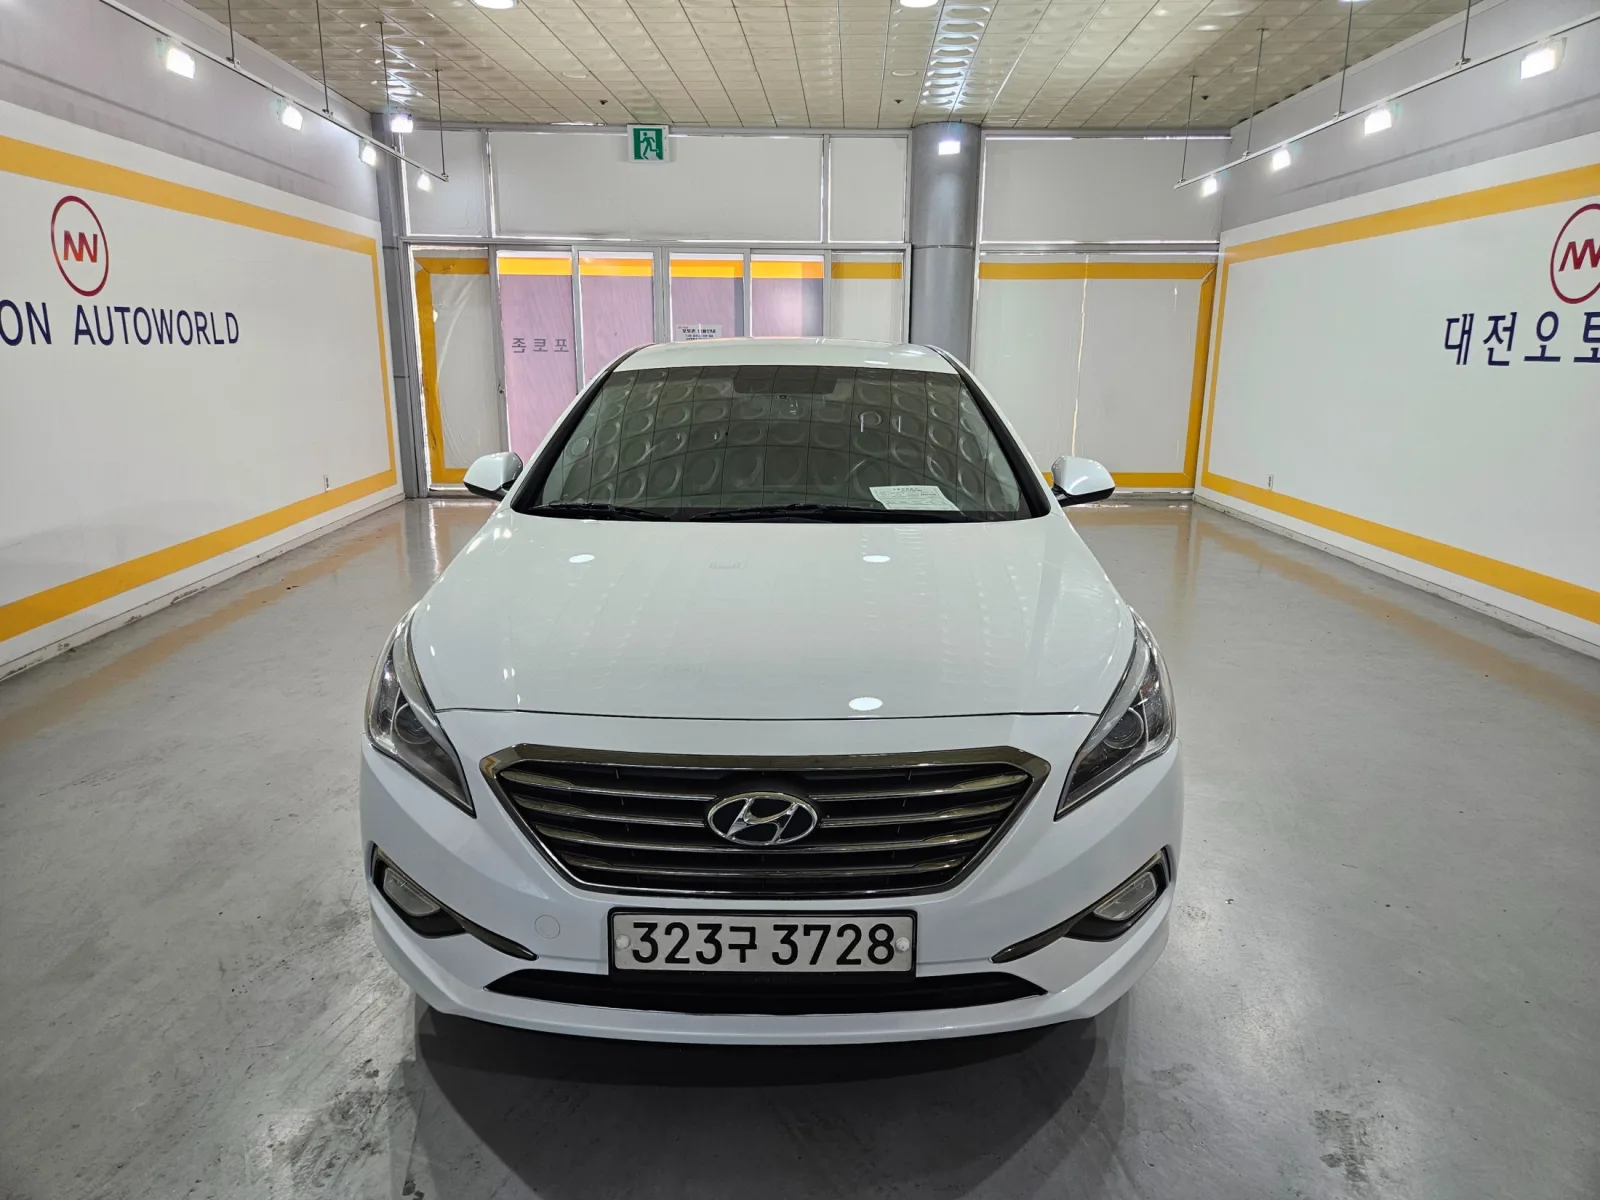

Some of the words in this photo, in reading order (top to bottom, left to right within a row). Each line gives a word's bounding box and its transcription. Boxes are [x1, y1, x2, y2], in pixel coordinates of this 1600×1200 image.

[0, 299, 52, 346] ON
[74, 304, 239, 346] AUTOWORLD
[632, 922, 757, 965] 323구
[772, 923, 895, 966] 3728
